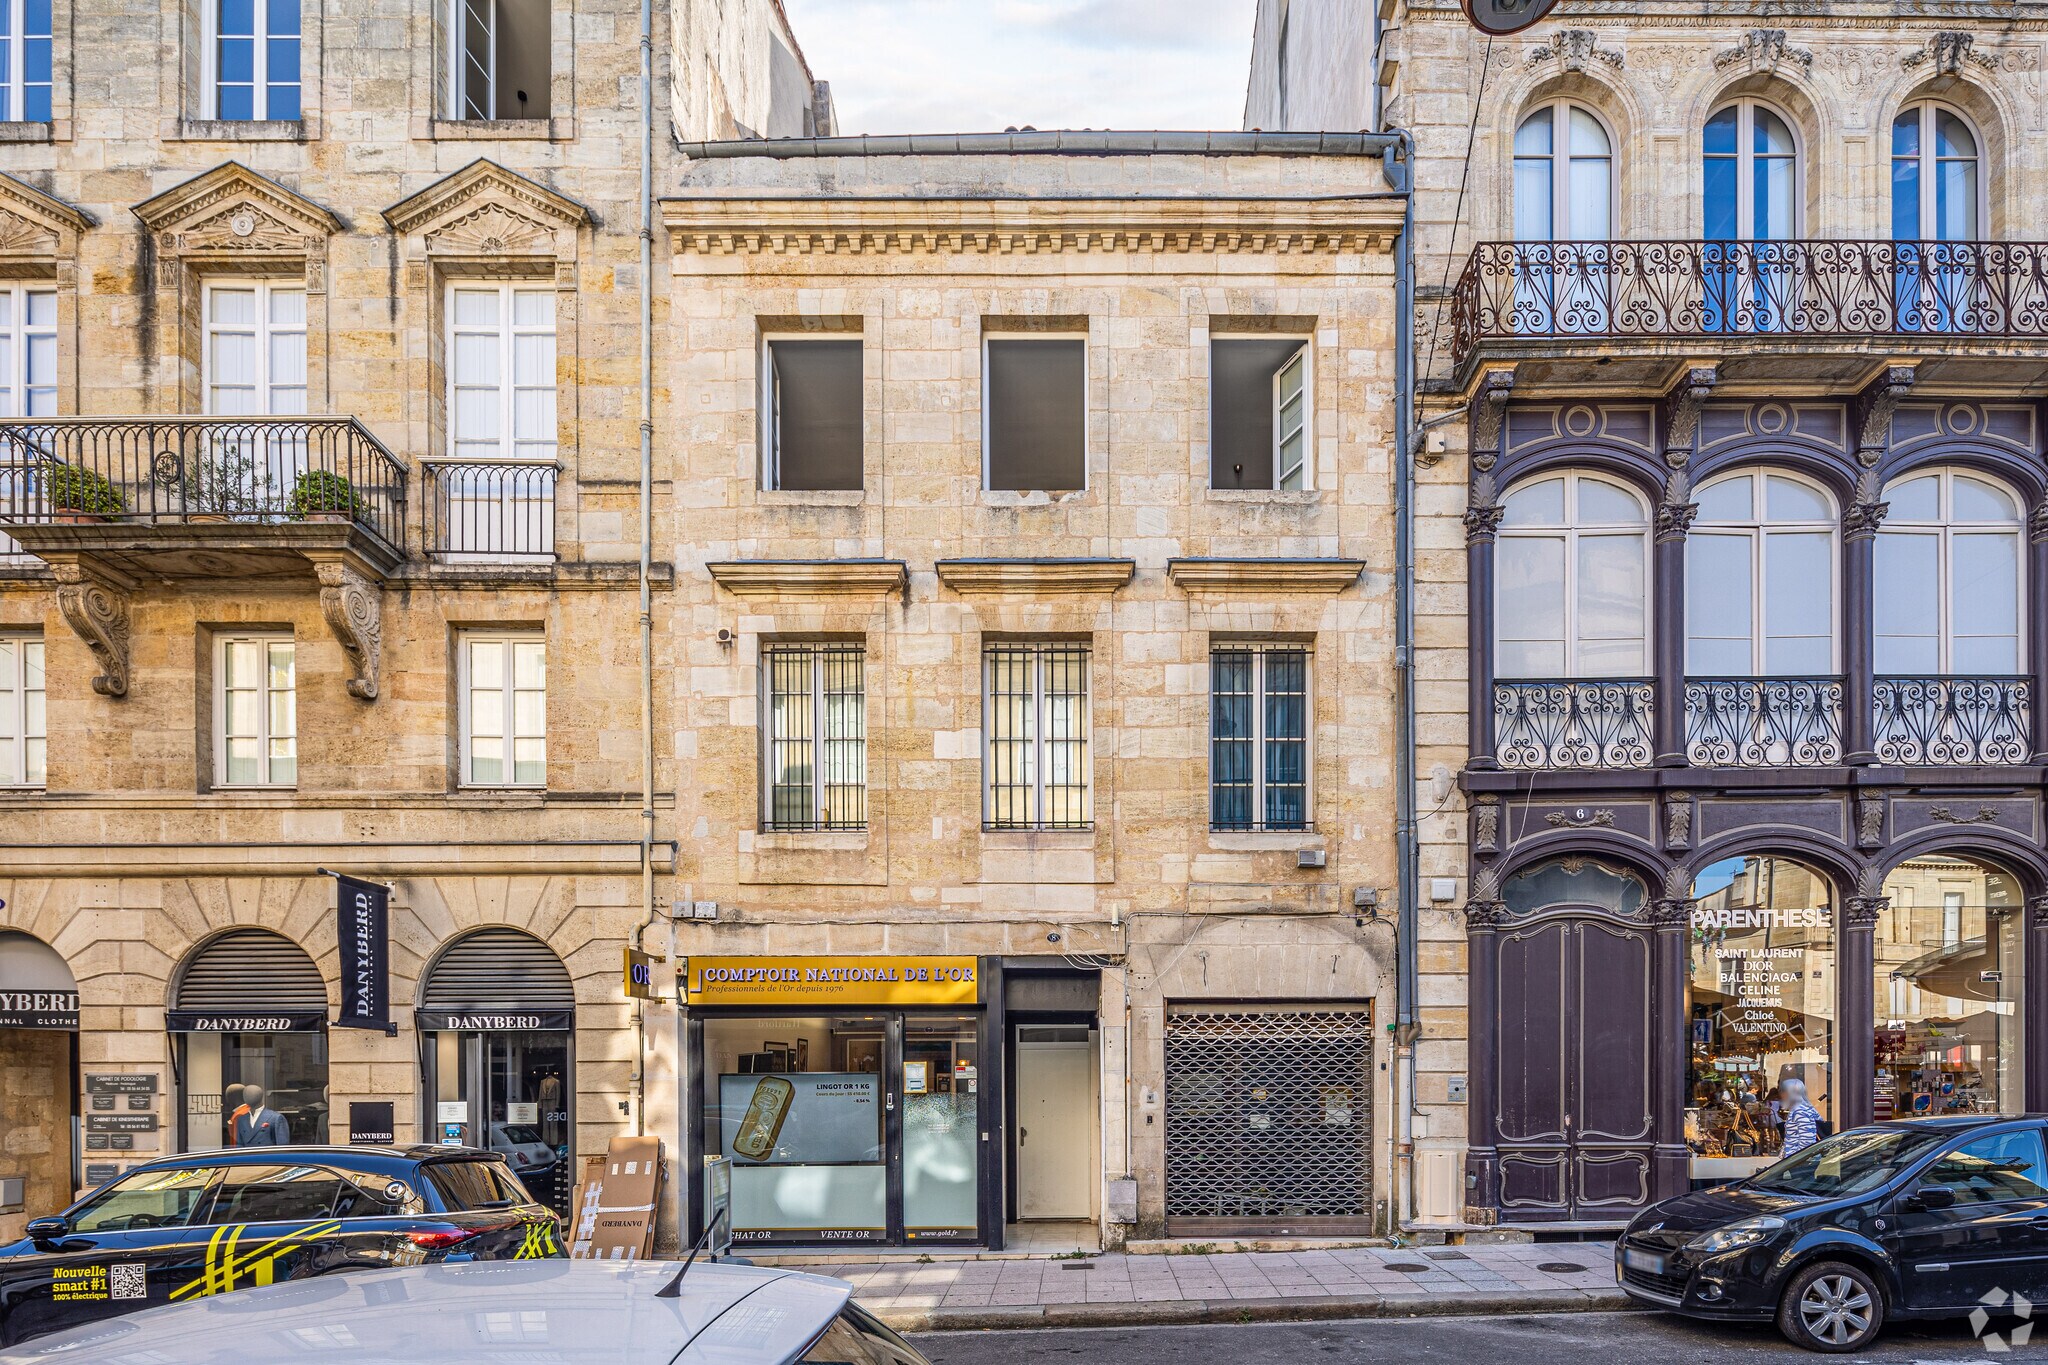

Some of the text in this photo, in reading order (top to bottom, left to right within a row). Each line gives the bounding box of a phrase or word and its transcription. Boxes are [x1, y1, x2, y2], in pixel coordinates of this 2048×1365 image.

[1576, 808, 1585, 819] 6
[1690, 908, 1831, 928] PARENTHESE
[355, 892, 369, 1017] DANYBERD
[1714, 949, 1804, 959] SAINT LAURENT
[1743, 961, 1774, 971] DIOR
[633, 963, 651, 985] OR
[705, 968, 975, 982] COMPTOIR NATIONAL DE L'OR
[1720, 973, 1798, 983] BALENCIAGA
[706, 984, 765, 993] Professionnels
[767, 984, 777, 992] de
[796, 984, 823, 993] depuis
[825, 985, 844, 993] 1976
[1738, 985, 1781, 995] CELINE
[0, 993, 80, 1012] YBERD
[1736, 997, 1783, 1008] JACQUEMUS
[1744, 1010, 1774, 1020] Chloé
[194, 1018, 291, 1030] DANYBERD
[447, 1016, 540, 1029] DANYBERD
[1732, 1022, 1787, 1033] VALENTINO
[351, 1132, 393, 1140] DANYBERD
[757, 1231, 772, 1239] OR
[820, 1230, 870, 1239] VENTE OR
[920, 1229, 959, 1237] www.gold.fr
[52, 1265, 107, 1279] Nouvelle
[52, 1278, 108, 1292] smart #1
[53, 1292, 108, 1301] 100% électrique
